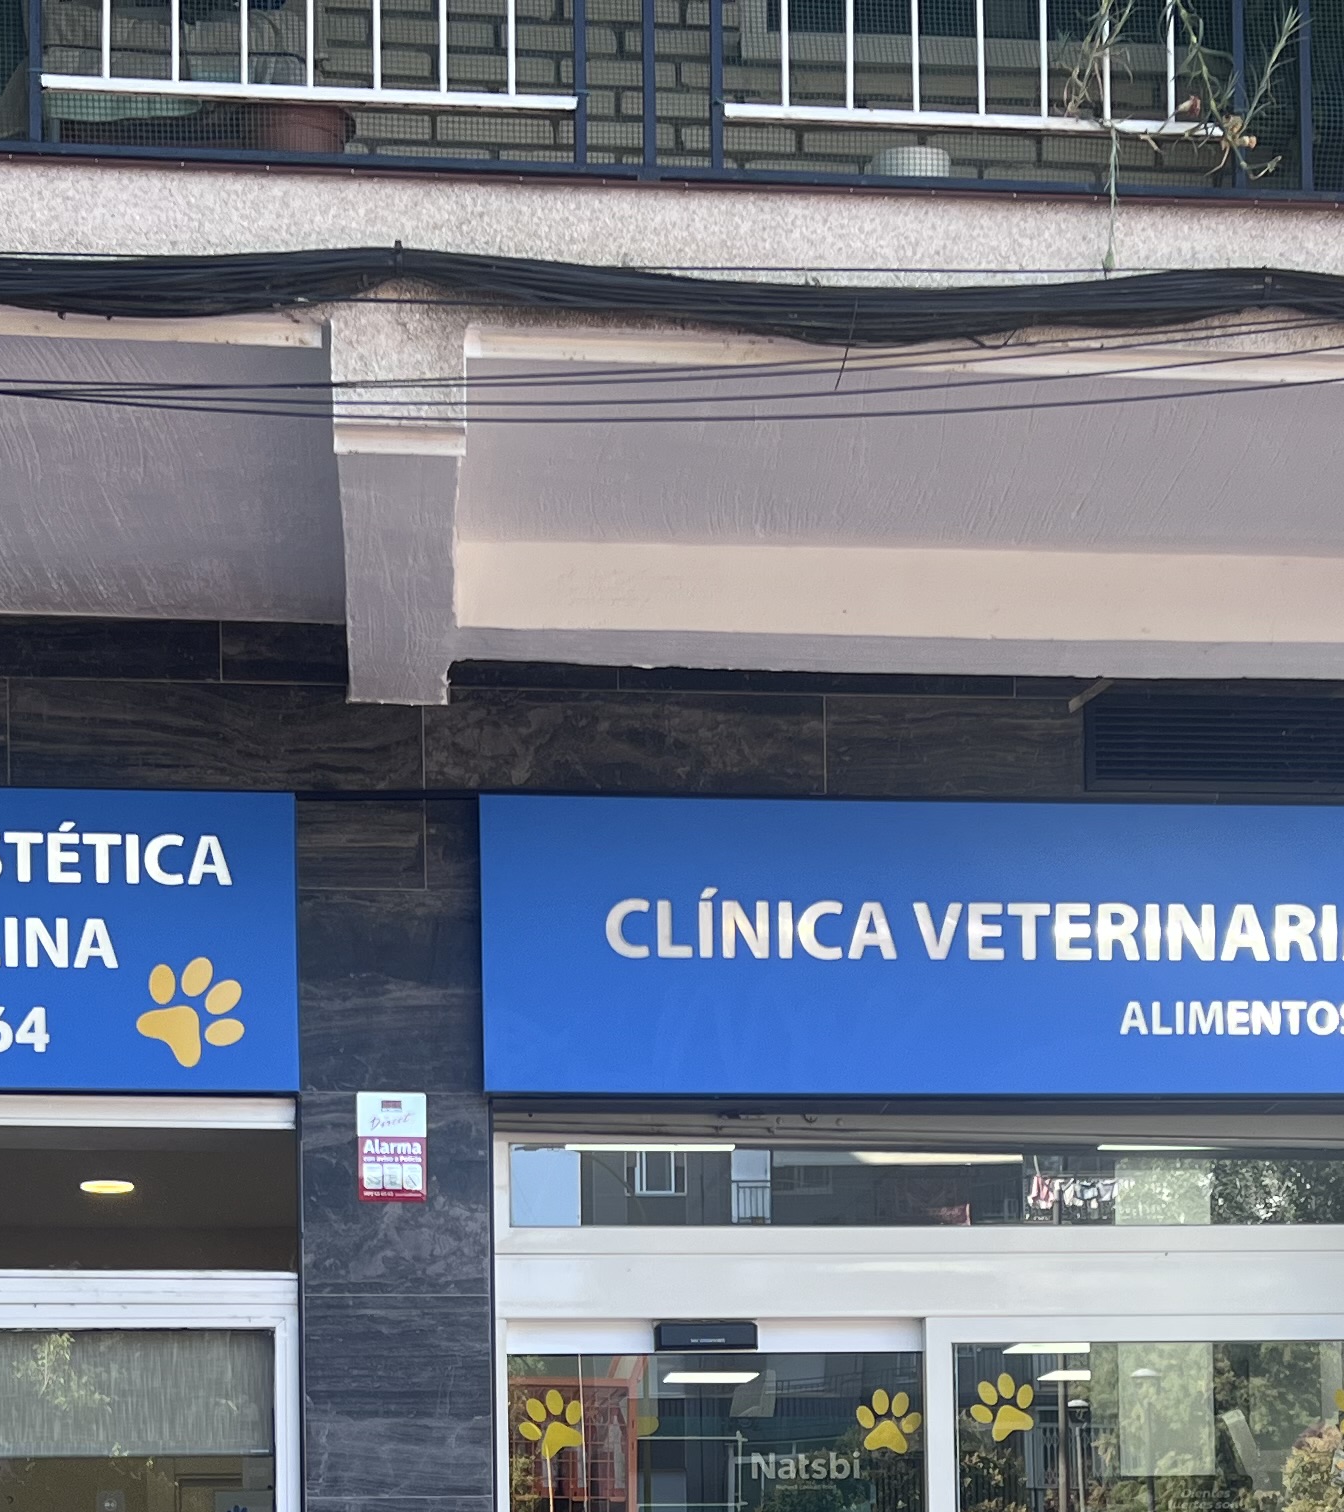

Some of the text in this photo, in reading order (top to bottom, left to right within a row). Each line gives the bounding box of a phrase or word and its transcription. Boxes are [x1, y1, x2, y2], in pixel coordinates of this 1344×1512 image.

[605, 887, 899, 962] CLÍNICA
[363, 1139, 422, 1154] Alarma
[751, 1451, 860, 1480] Natsbi
